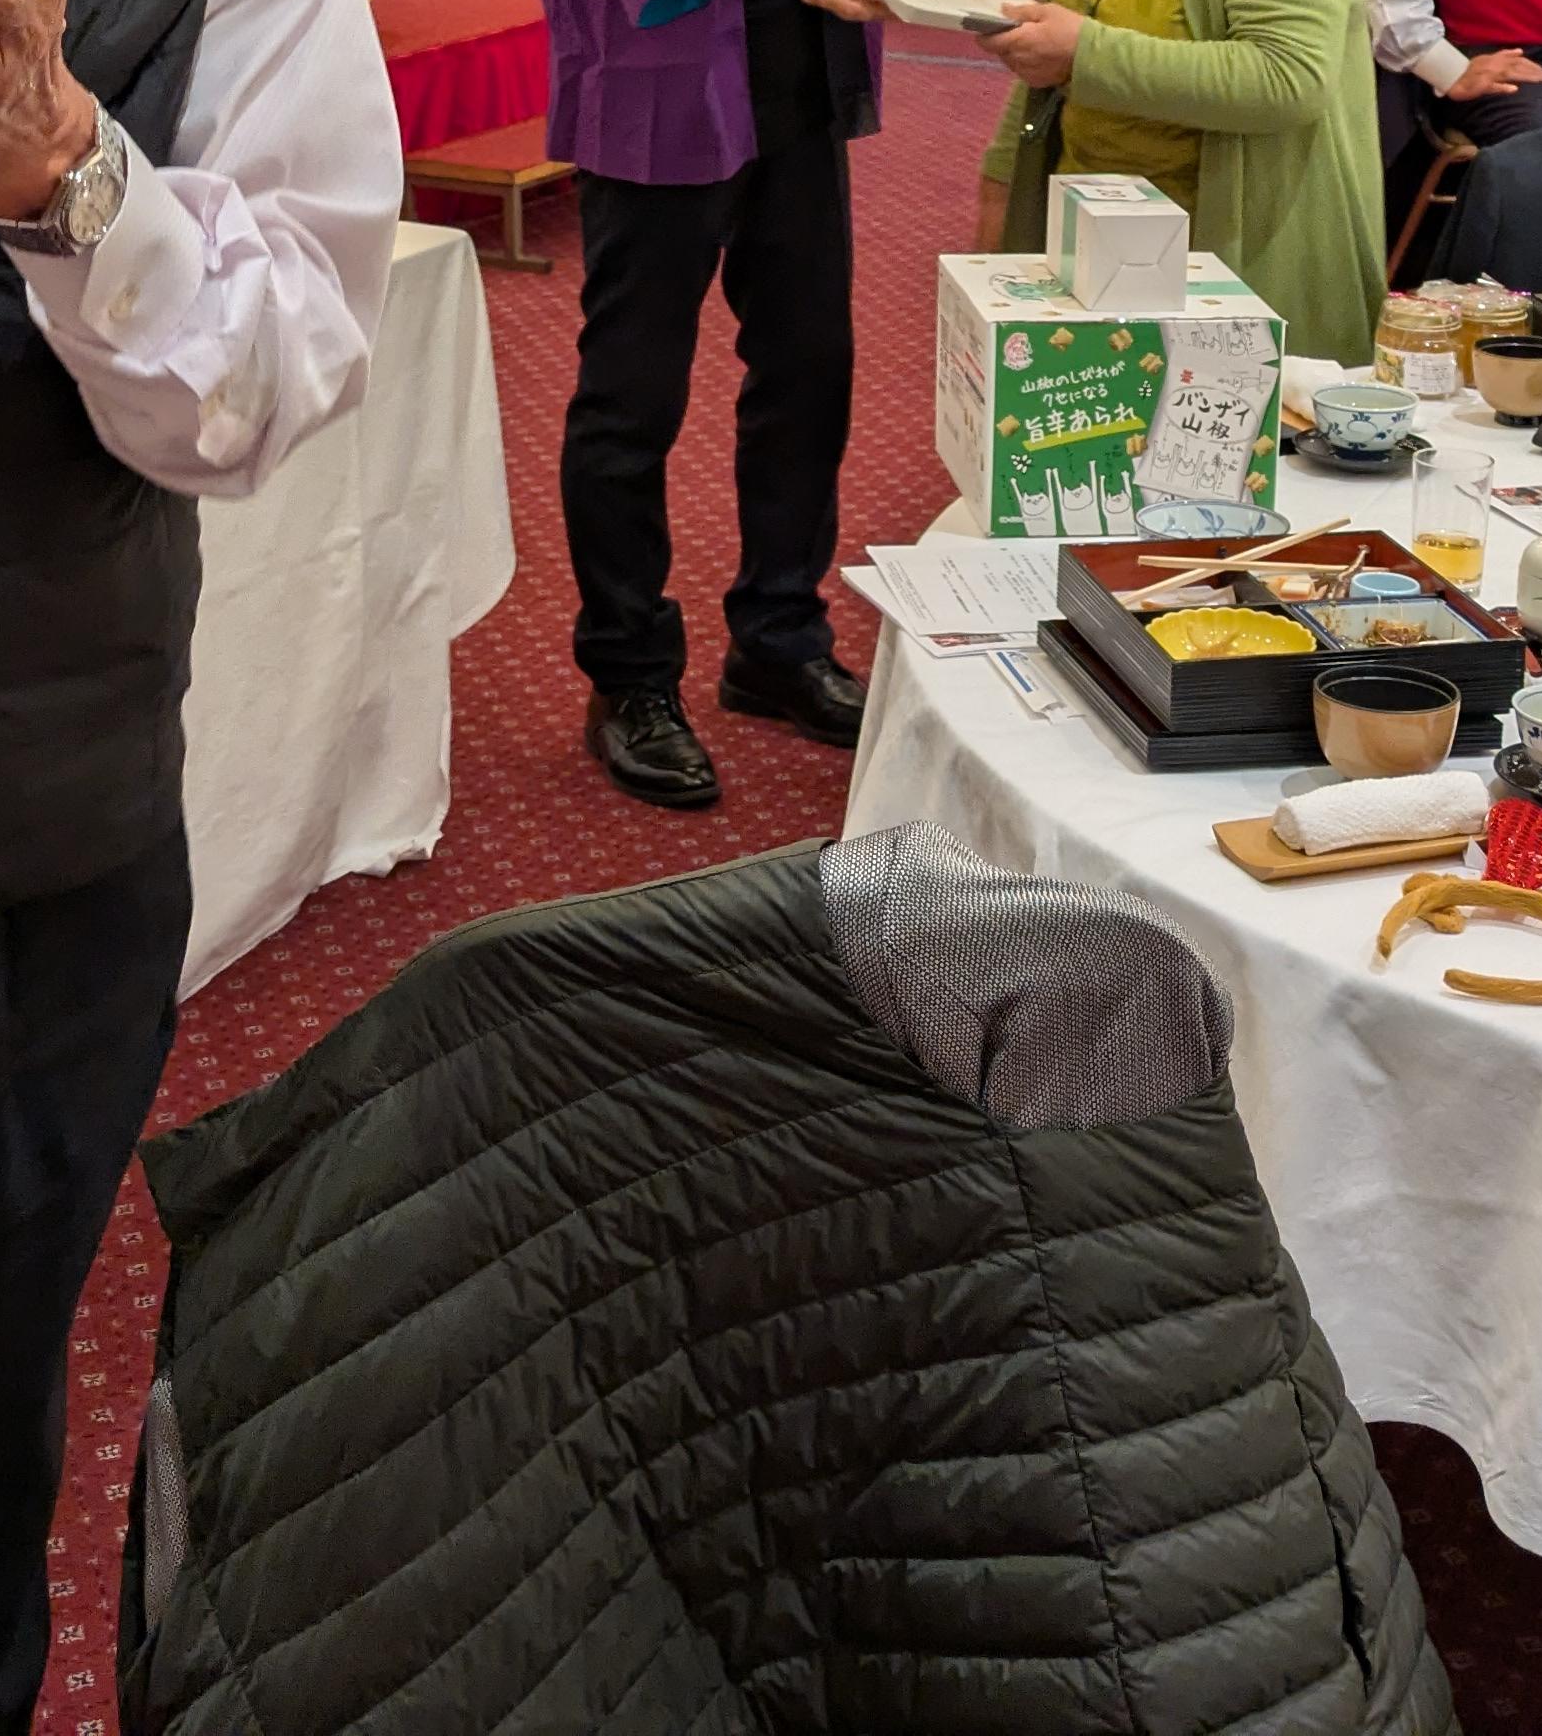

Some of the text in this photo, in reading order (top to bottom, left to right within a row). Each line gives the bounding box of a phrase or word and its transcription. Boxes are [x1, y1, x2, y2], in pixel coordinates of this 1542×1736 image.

[1020, 360, 1126, 394] 山椒のしびれが
[1042, 384, 1109, 407] クセになる
[1172, 392, 1251, 427] バンザイ
[1025, 403, 1138, 444] 旨辛あられ
[1181, 413, 1232, 440] 山椒
